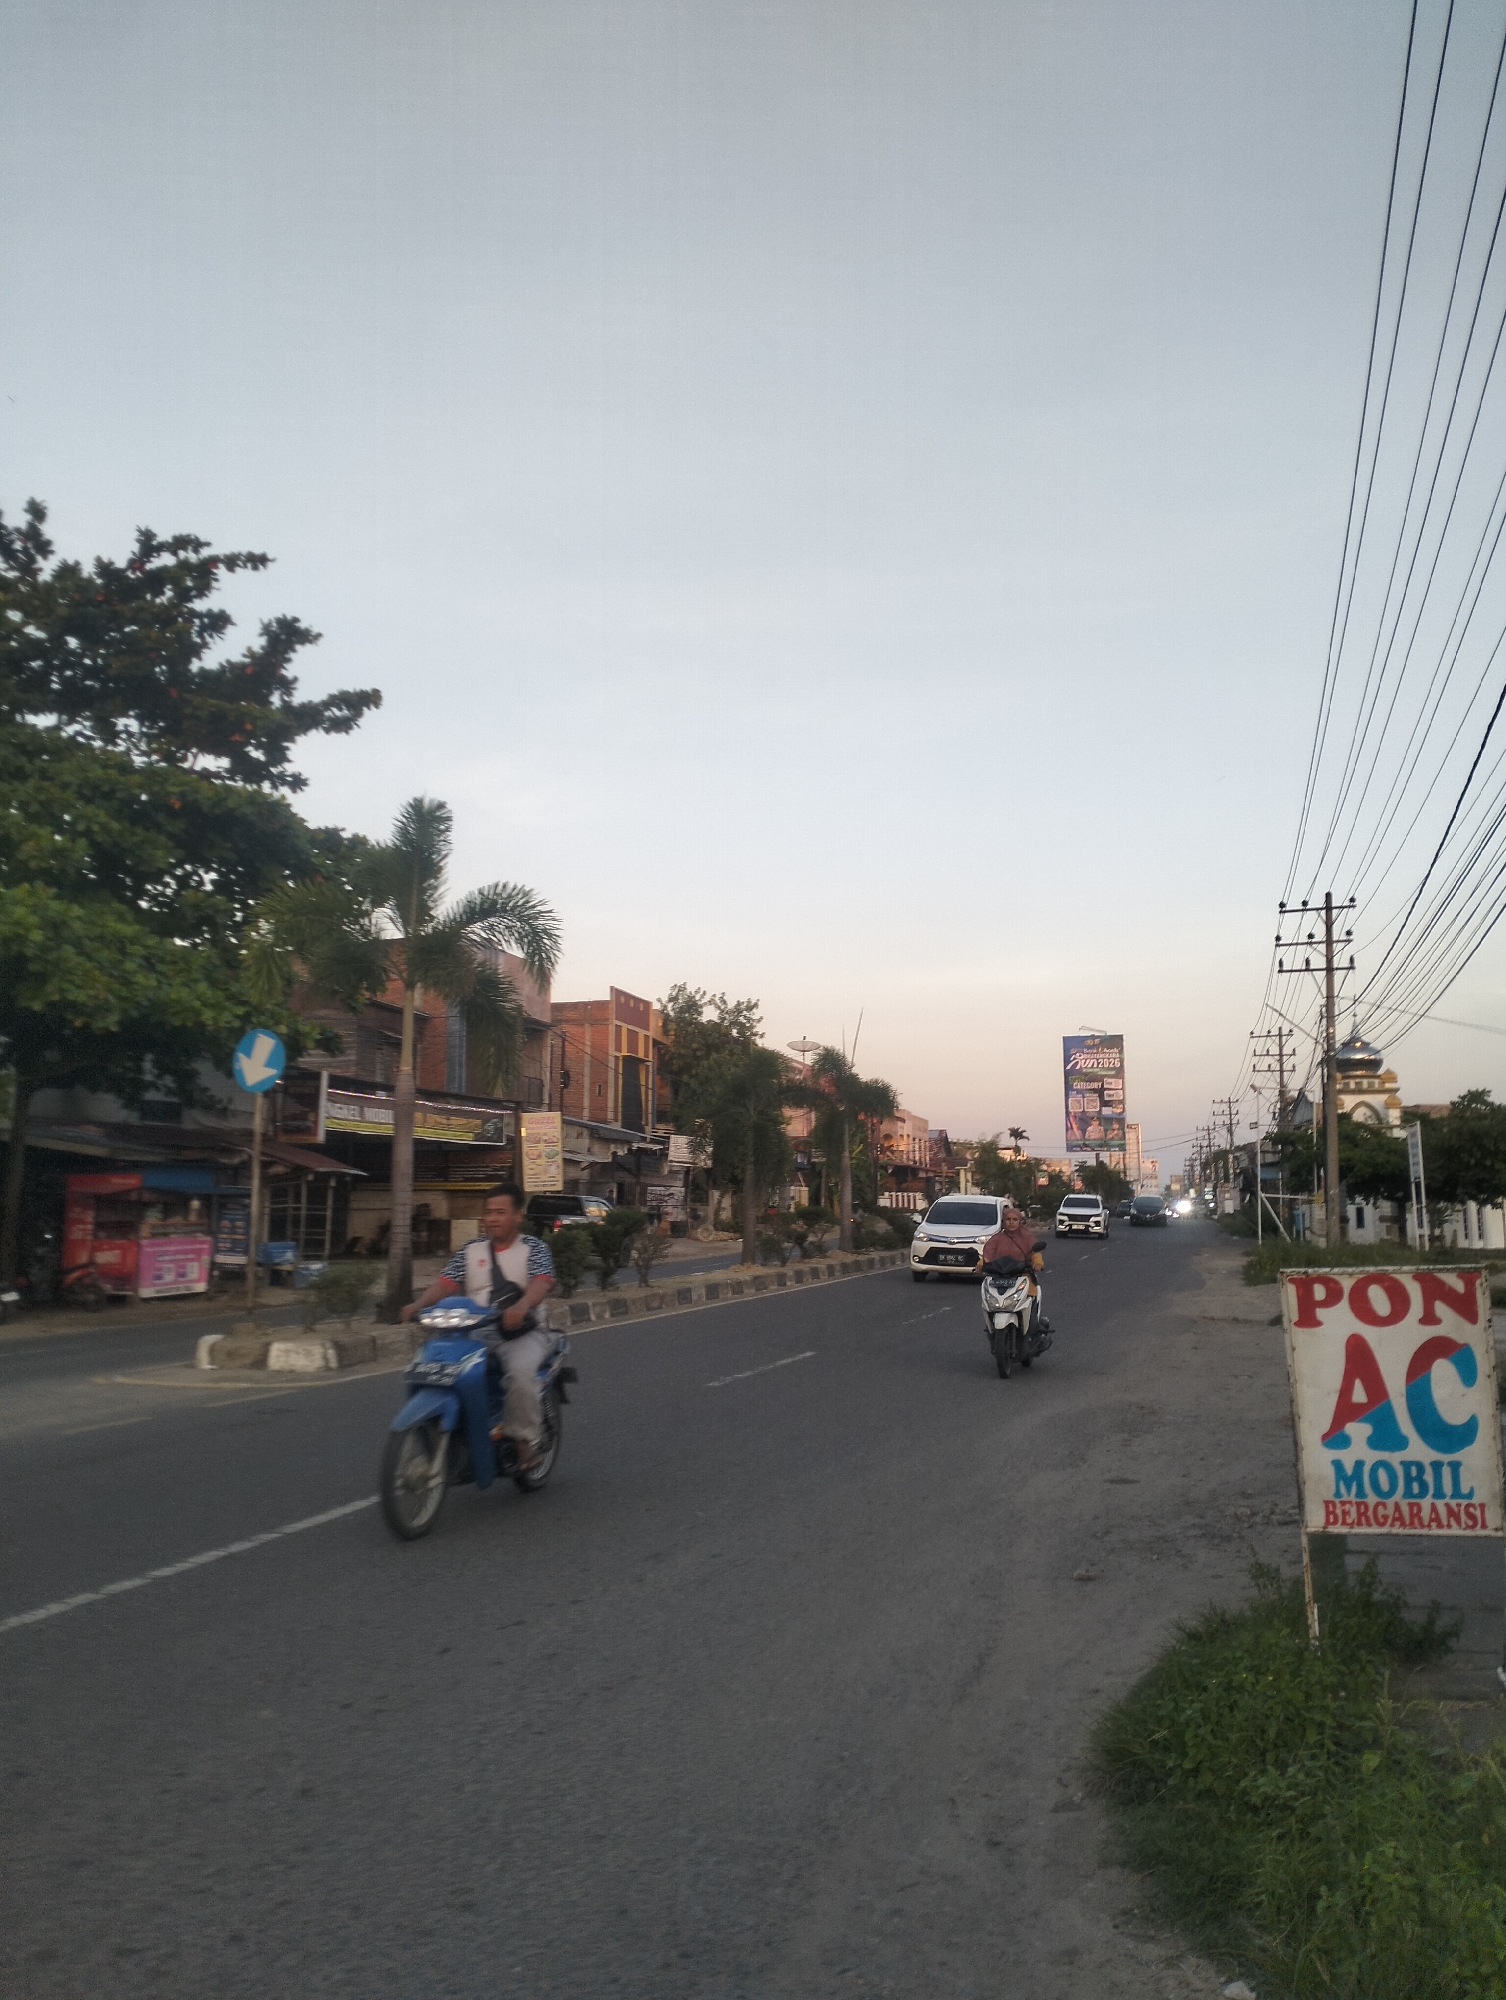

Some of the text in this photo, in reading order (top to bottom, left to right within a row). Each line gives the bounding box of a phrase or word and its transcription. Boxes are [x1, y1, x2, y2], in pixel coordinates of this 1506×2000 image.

[1098, 1058, 1121, 1068] 2026
[1073, 1081, 1103, 1089] CATEGORY
[1287, 1272, 1482, 1329] PON
[1321, 1333, 1479, 1455] AC
[1330, 1459, 1475, 1500] MOBIL
[1323, 1500, 1489, 1530] BERGARANSI
